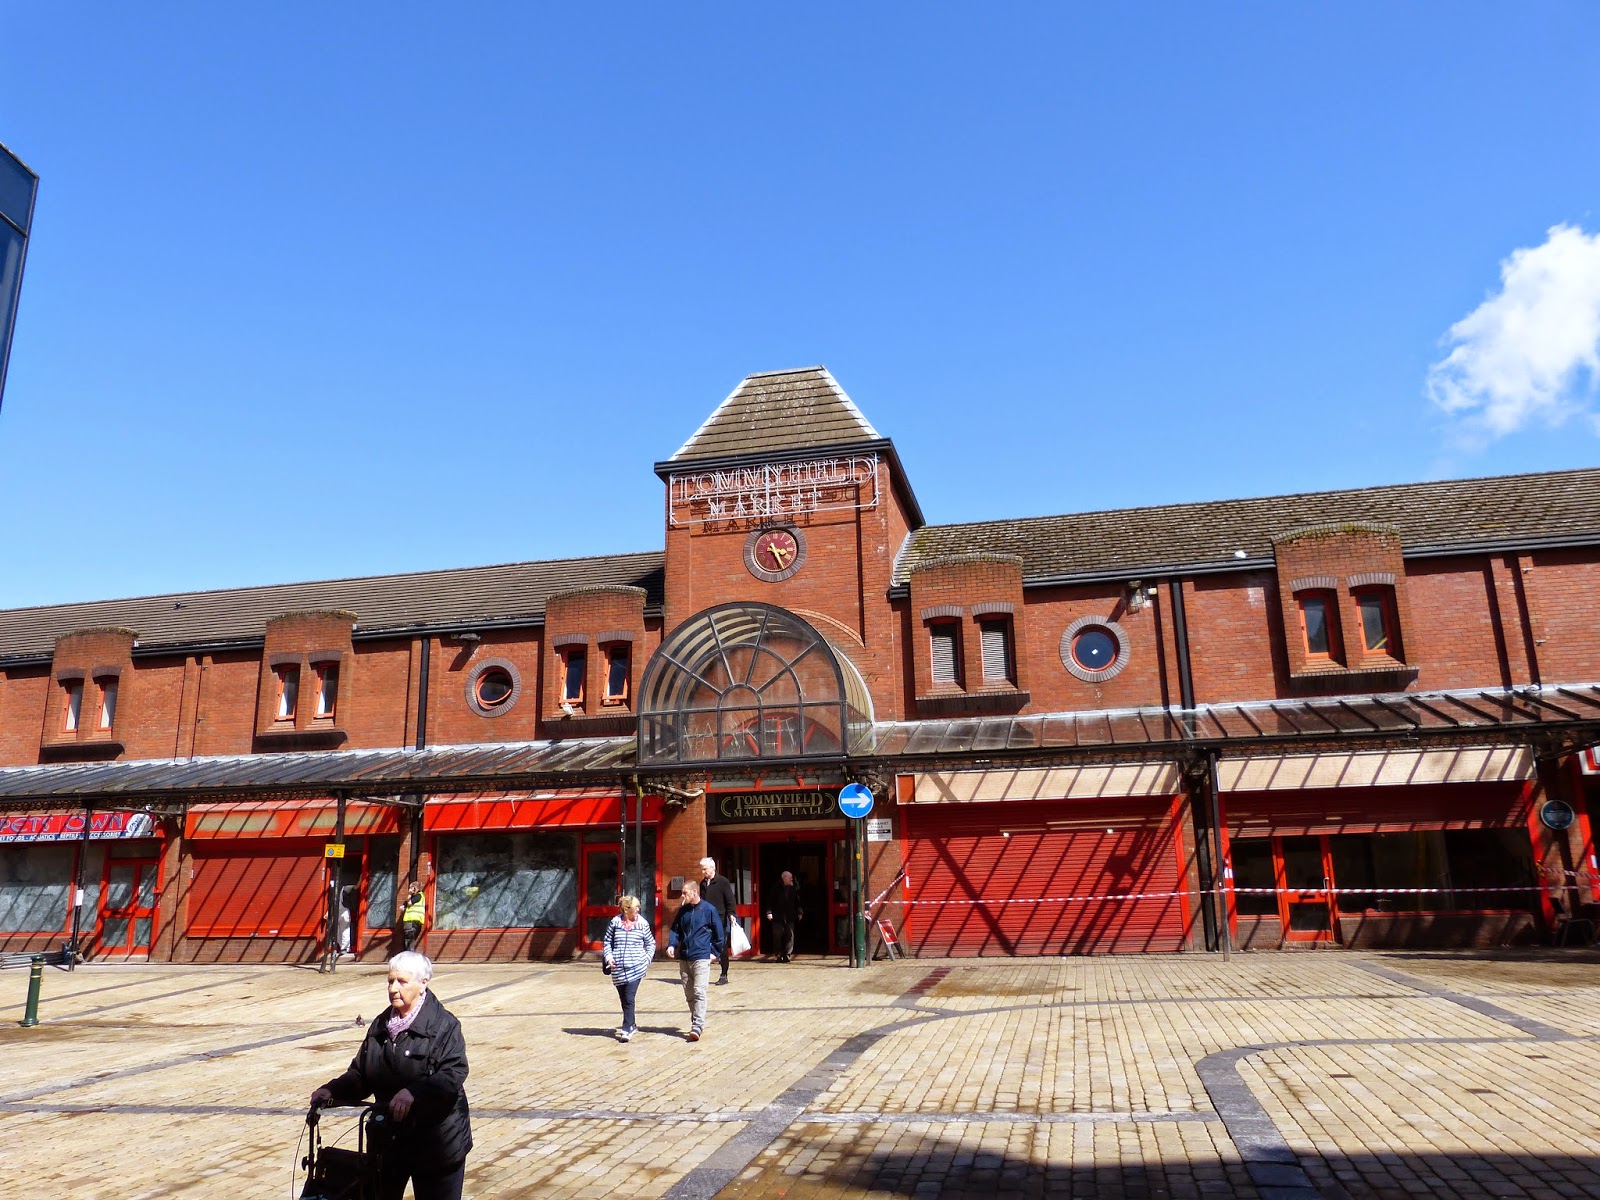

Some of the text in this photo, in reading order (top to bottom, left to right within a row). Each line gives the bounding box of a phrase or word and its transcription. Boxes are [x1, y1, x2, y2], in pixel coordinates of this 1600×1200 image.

[672, 456, 875, 500] TOMMYFIELD
[709, 491, 822, 516] MARKET
[733, 792, 824, 810] TOMMYFIELD
[733, 806, 824, 818] MARKET HALL
[66, 813, 123, 831] OWN
